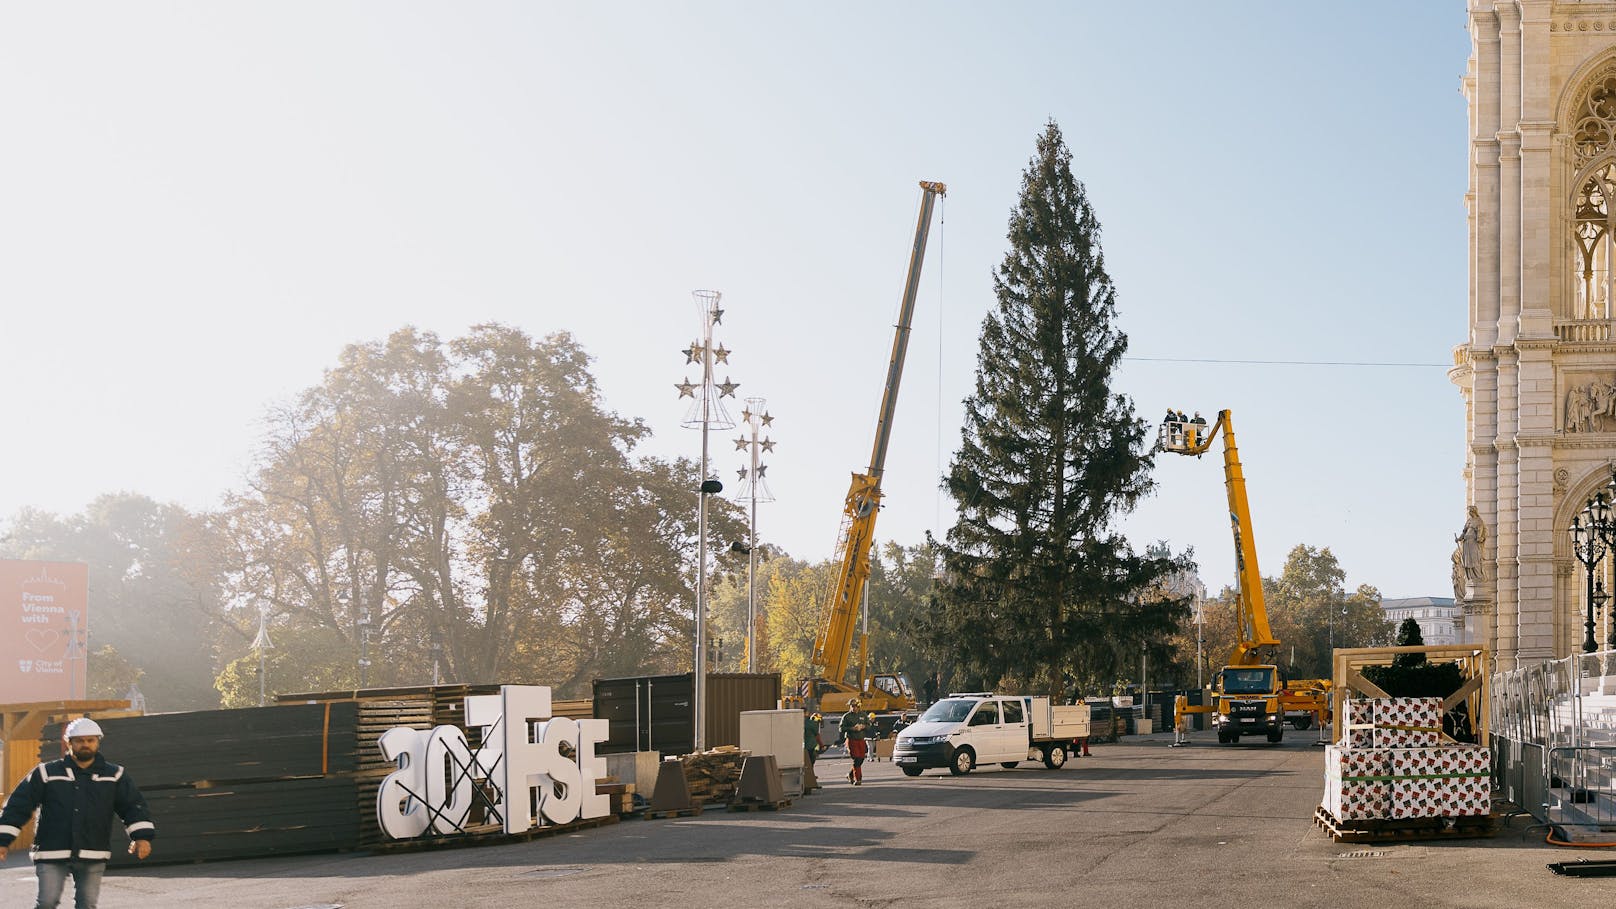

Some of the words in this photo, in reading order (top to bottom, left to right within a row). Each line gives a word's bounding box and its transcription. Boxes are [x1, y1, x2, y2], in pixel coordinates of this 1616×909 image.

[22, 592, 54, 602] From
[22, 603, 64, 613] Vienna
[22, 614, 48, 623] with
